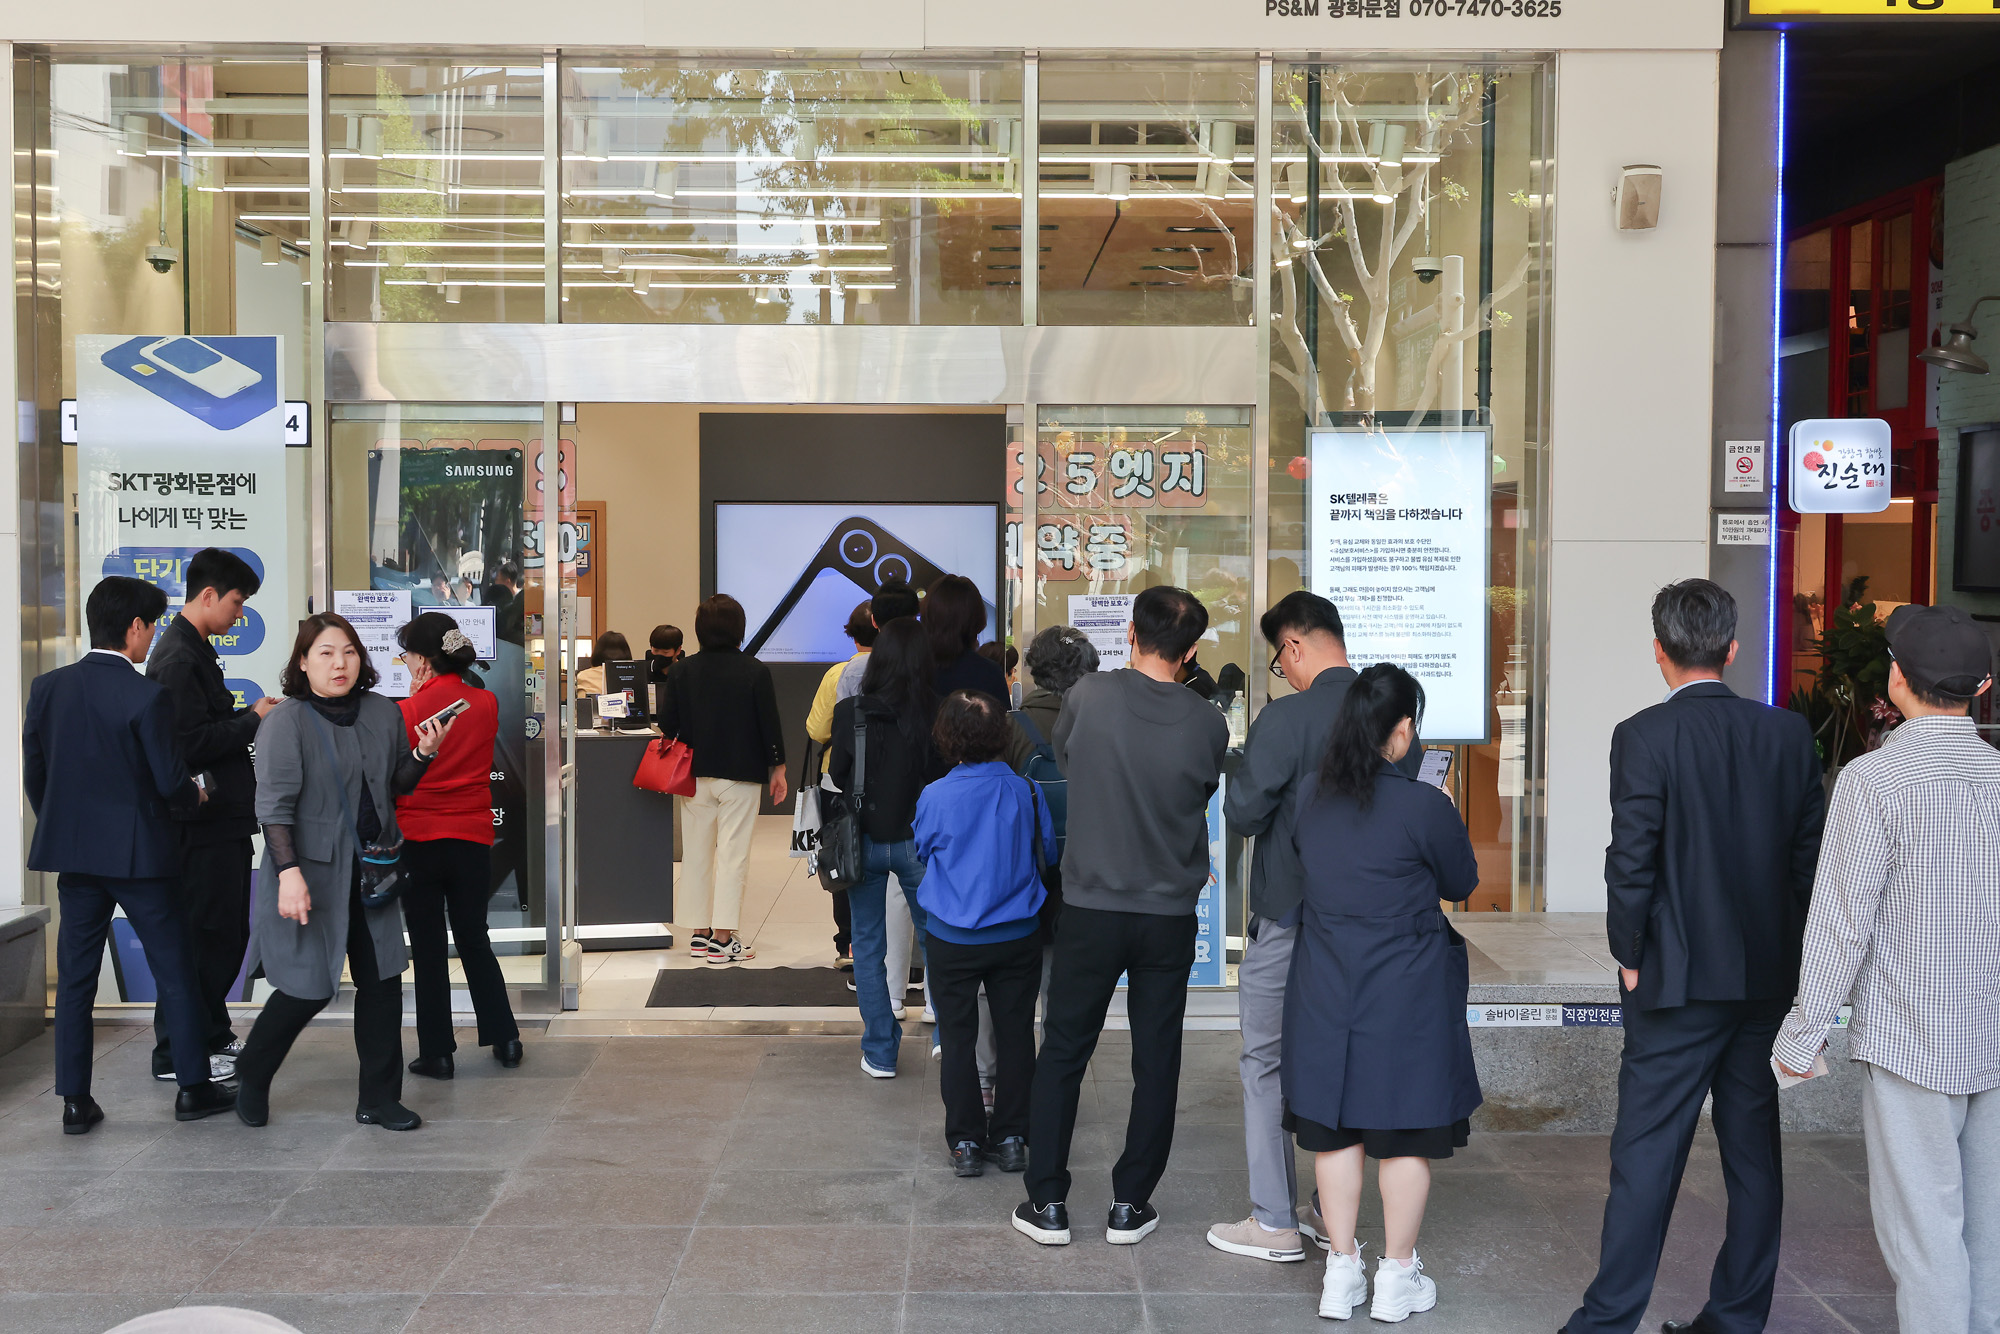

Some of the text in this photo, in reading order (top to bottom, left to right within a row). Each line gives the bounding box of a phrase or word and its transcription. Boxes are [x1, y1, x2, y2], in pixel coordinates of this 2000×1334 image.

[1265, 0, 1561, 18] PS&M 광화문점 070-7470-3625
[1728, 445, 1761, 454] 금연건물
[444, 464, 514, 478] SAMSUNG
[1816, 462, 1886, 490] 진순대
[108, 472, 256, 496] SKT광화문점에
[1330, 492, 1388, 505] SK텔레콤은
[118, 507, 248, 530] 나에게 딱 맞는
[1330, 508, 1462, 521] 끝까지 책임을 다하겠습니다
[133, 558, 182, 584] 단기
[1484, 1008, 1542, 1022] 솔바이올린
